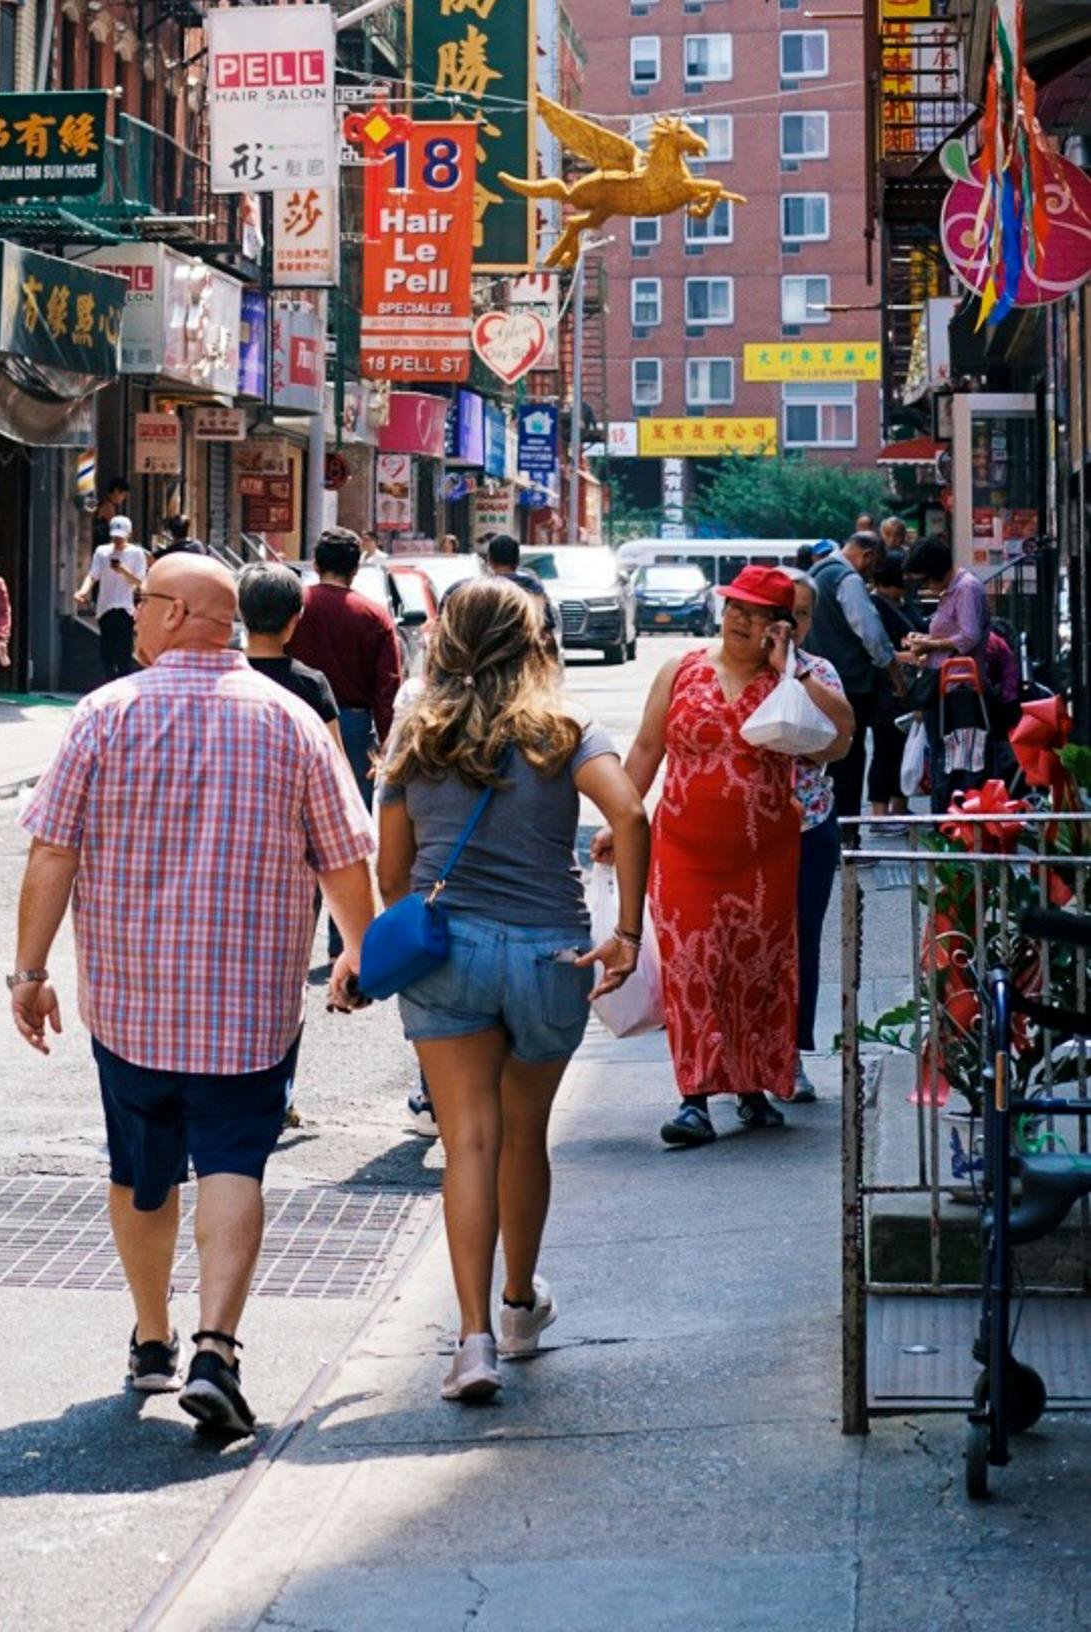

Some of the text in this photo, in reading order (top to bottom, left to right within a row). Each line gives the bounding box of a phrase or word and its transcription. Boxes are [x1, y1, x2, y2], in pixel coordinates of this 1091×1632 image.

[216, 52, 324, 87] PELL
[215, 87, 327, 103] HAIR SALON
[25, 164, 42, 180] DIM
[43, 164, 64, 179] SUM
[65, 163, 97, 179] HOUSE
[384, 137, 462, 194] 18
[380, 208, 453, 234] Hair
[394, 239, 437, 263] Le
[384, 269, 448, 294] Pell
[127, 294, 153, 303] LON
[378, 303, 452, 315] SPECIALIZE
[366, 355, 463, 373] 18 PELL ST
